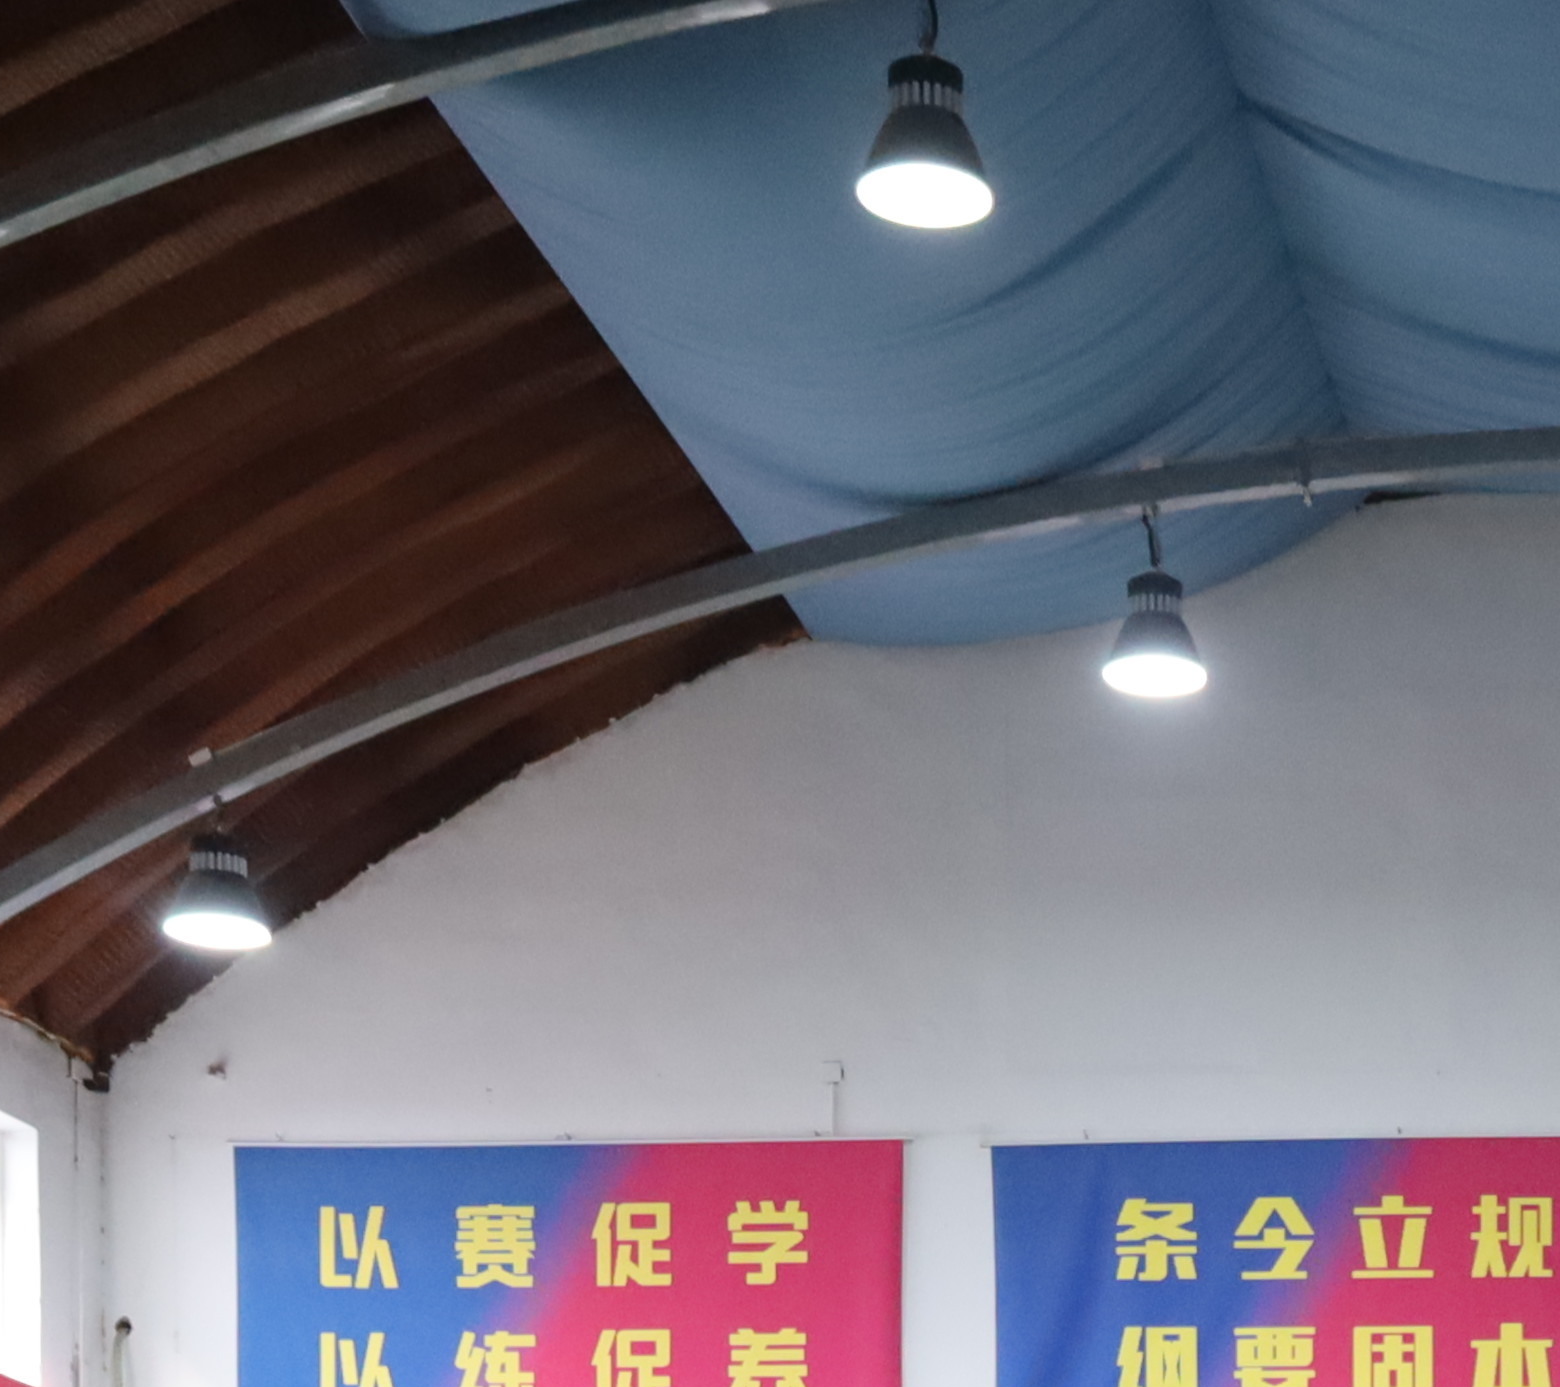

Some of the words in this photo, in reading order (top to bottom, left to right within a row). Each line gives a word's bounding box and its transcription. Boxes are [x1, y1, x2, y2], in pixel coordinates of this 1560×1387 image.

[322, 1201, 808, 1287] 以赛促学
[1118, 1195, 1552, 1280] 条令立规
